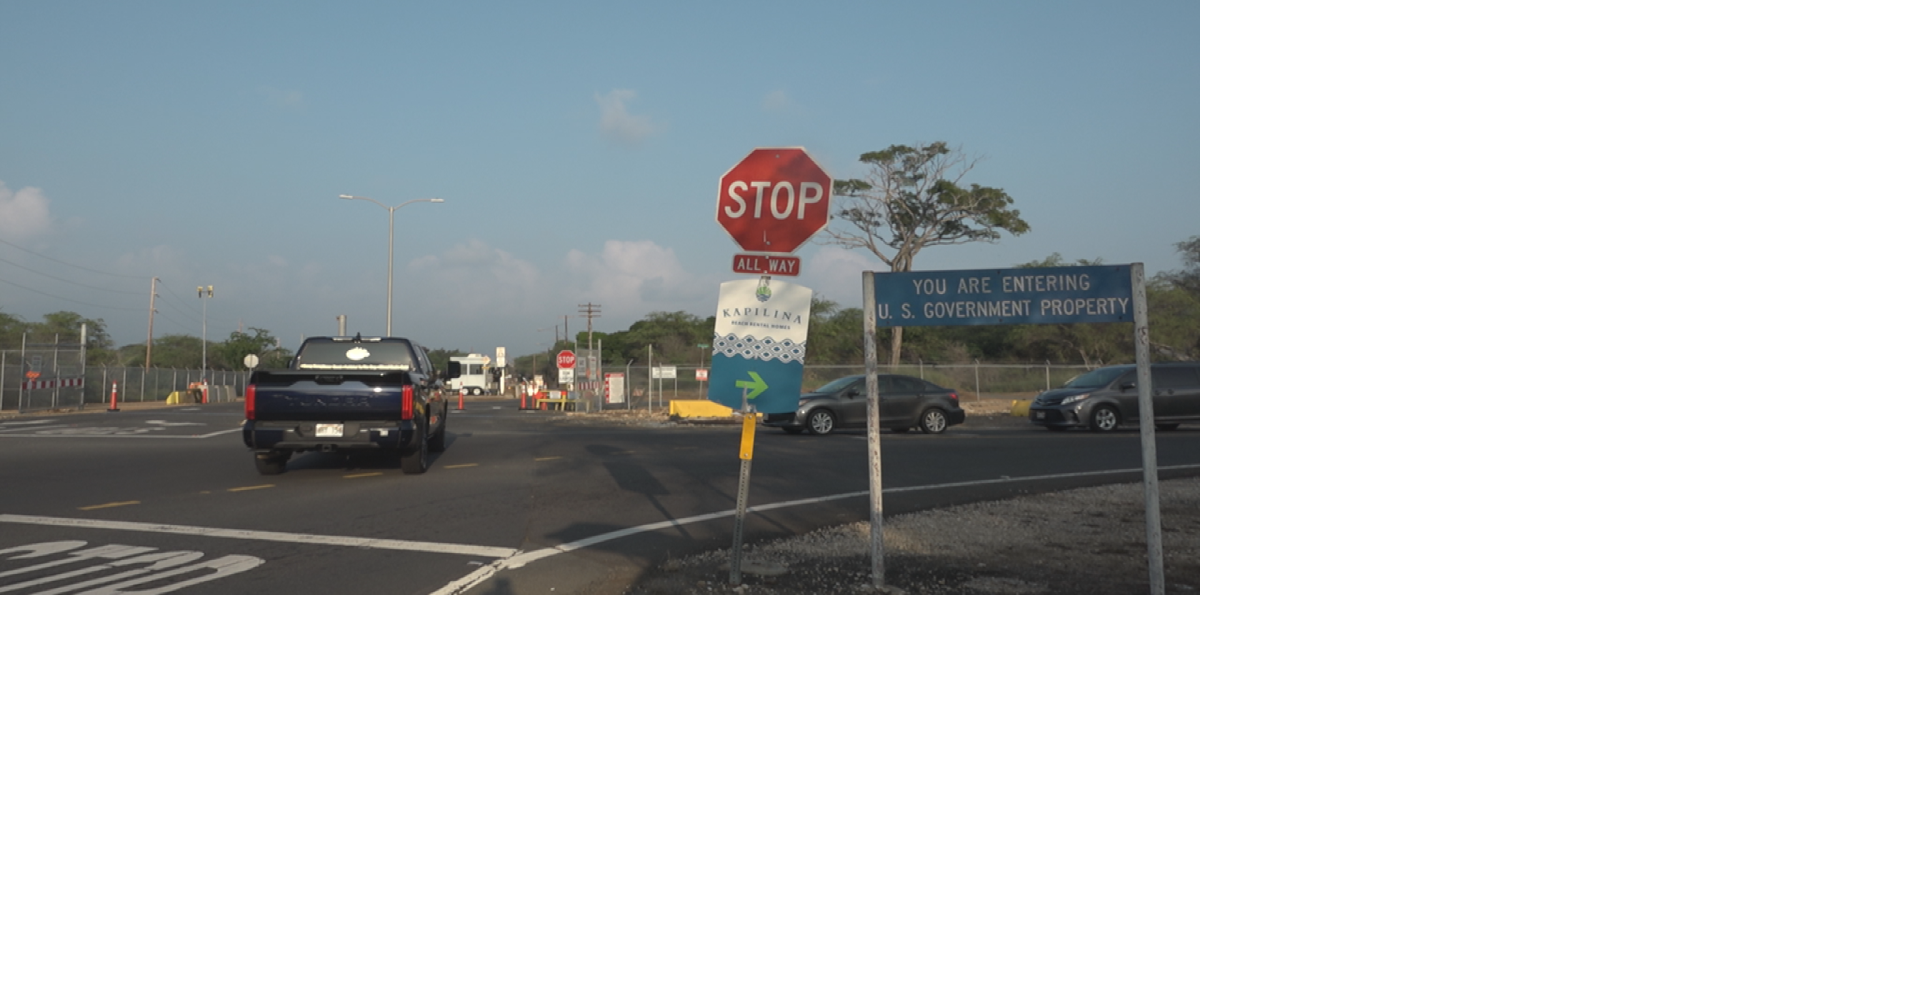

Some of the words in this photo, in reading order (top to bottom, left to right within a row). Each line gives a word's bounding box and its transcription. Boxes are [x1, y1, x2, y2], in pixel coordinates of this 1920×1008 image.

[724, 181, 823, 220] STOP
[737, 258, 761, 271] ALL
[768, 259, 796, 273] WAY
[913, 278, 947, 296] YOU
[957, 276, 992, 294] ARE
[1002, 273, 1091, 293] ENTERING
[722, 308, 802, 325] KAPILINA
[878, 303, 893, 320] U.
[901, 302, 916, 319] S.
[923, 299, 1032, 319] GOVERNMENT
[1040, 297, 1130, 316] PROPERTY
[749, 321, 770, 329] RENTAL
[558, 356, 575, 364] STOP
